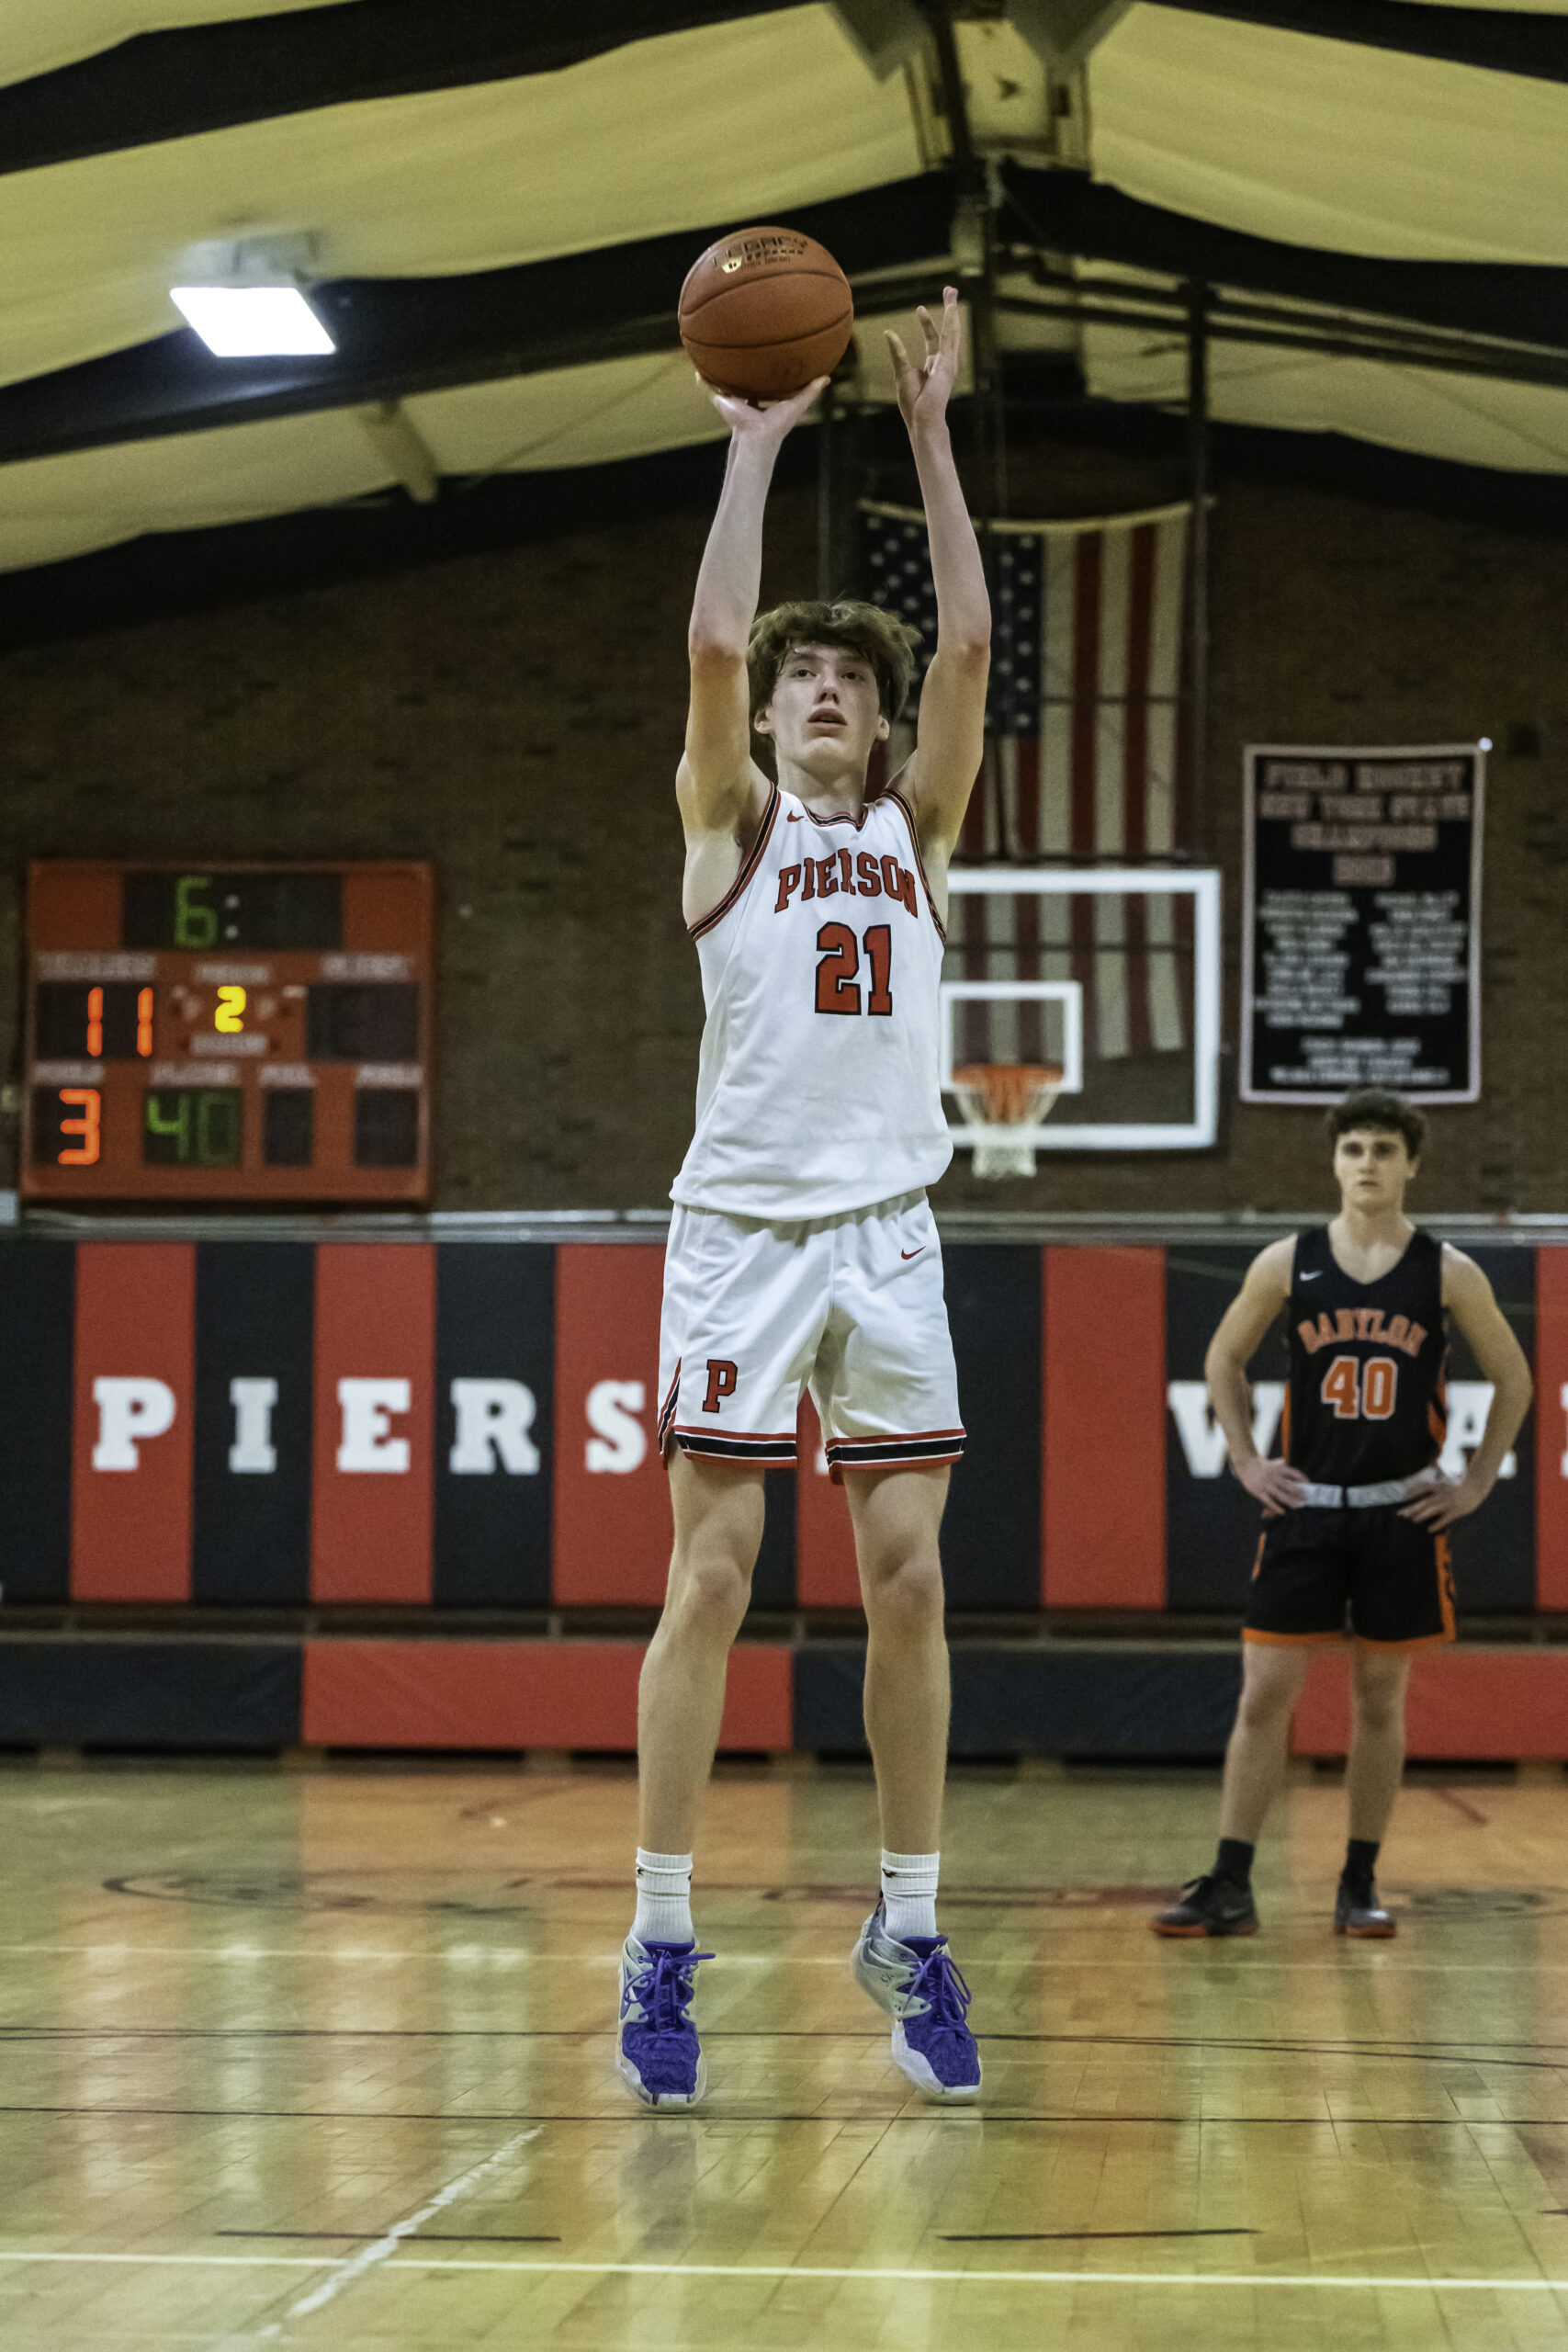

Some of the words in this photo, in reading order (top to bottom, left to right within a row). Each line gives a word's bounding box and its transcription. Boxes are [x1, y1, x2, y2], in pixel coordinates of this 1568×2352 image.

[774, 848, 919, 919] PIERSON
[815, 922, 892, 1016] 21
[87, 986, 153, 1057] 11
[214, 985, 247, 1033] 2
[58, 1089, 101, 1165] 3
[1297, 1308, 1429, 1358] BABYLON
[702, 1359, 738, 1413] P
[1321, 1355, 1398, 1420] 40
